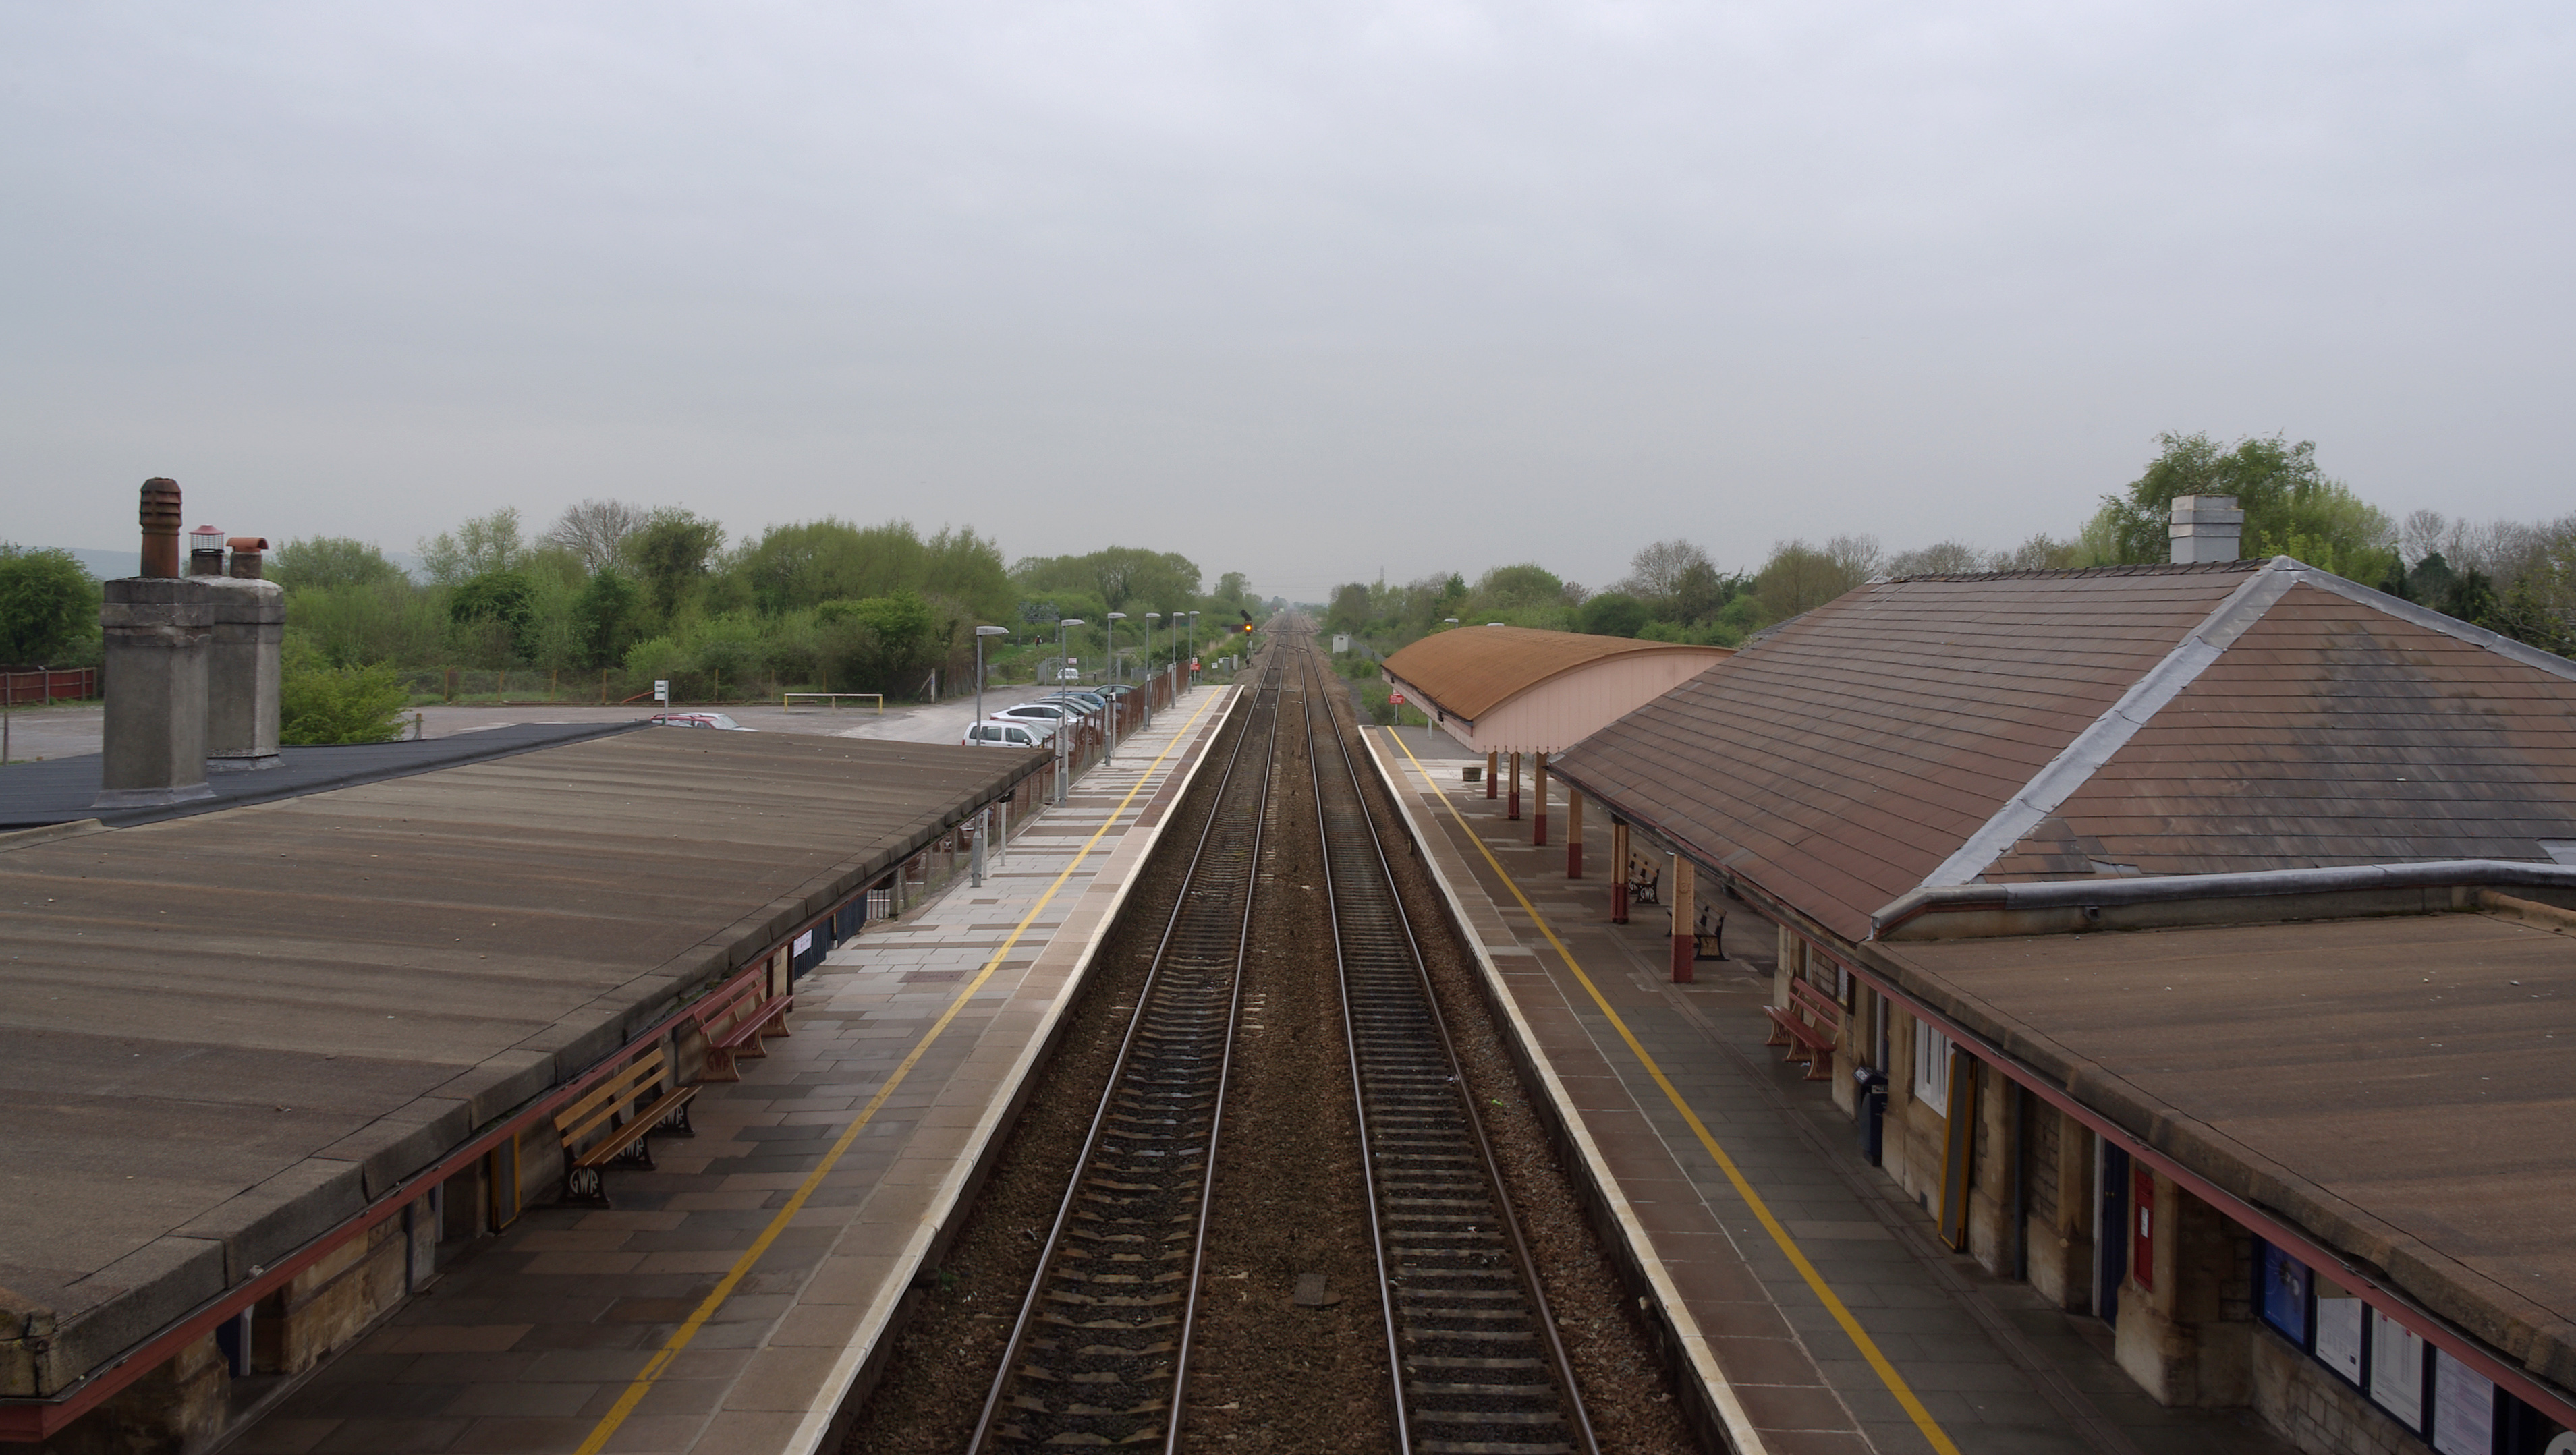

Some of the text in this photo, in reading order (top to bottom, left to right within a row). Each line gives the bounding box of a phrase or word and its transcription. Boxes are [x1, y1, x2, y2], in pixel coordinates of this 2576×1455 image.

[1640, 886, 1655, 900] GWR
[707, 1050, 730, 1073] GWR
[619, 1136, 644, 1157] WR
[569, 1167, 599, 1194] GWR
